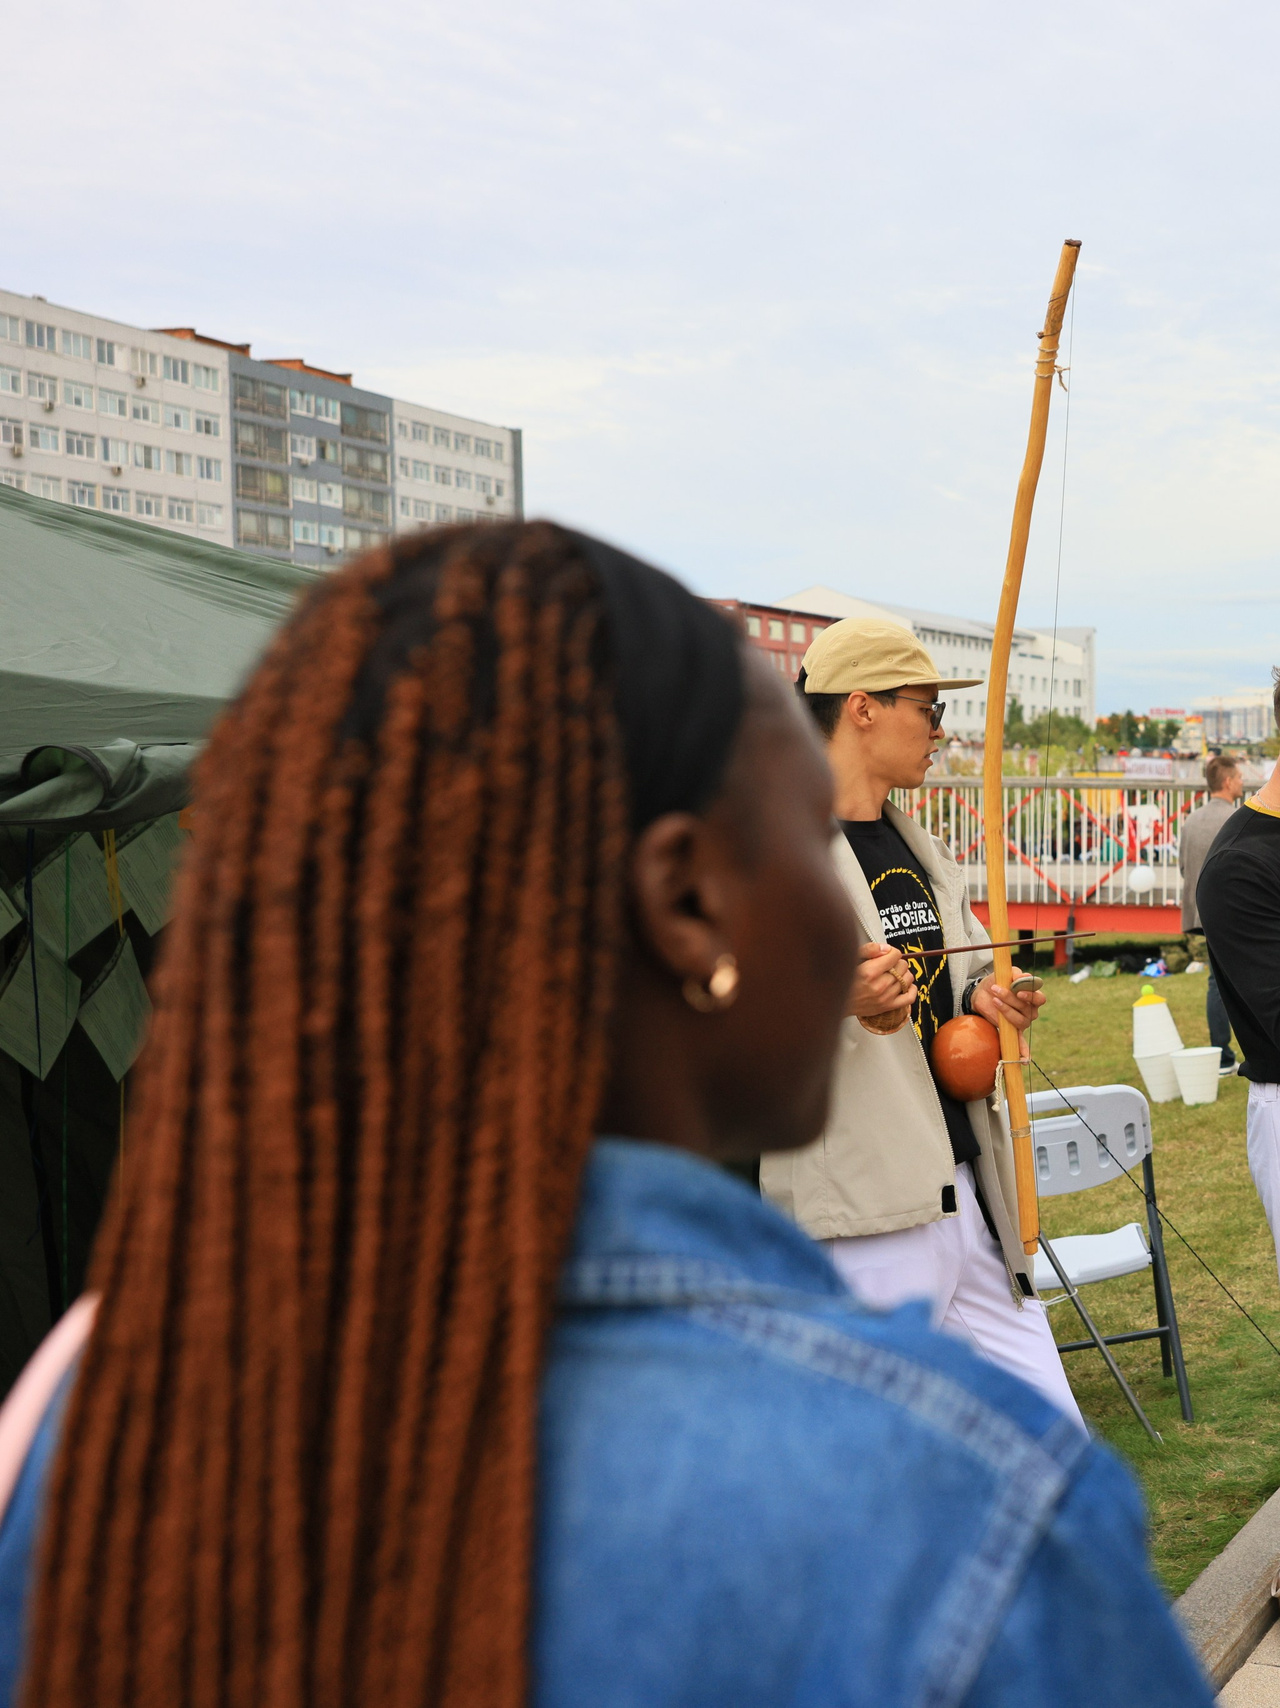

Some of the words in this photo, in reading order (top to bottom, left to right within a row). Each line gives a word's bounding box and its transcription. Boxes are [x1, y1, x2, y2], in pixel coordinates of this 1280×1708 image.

[880, 904, 903, 916] ordão
[905, 902, 912, 910] de
[912, 901, 928, 910] Ouro
[882, 909, 938, 932] APOEIRA
